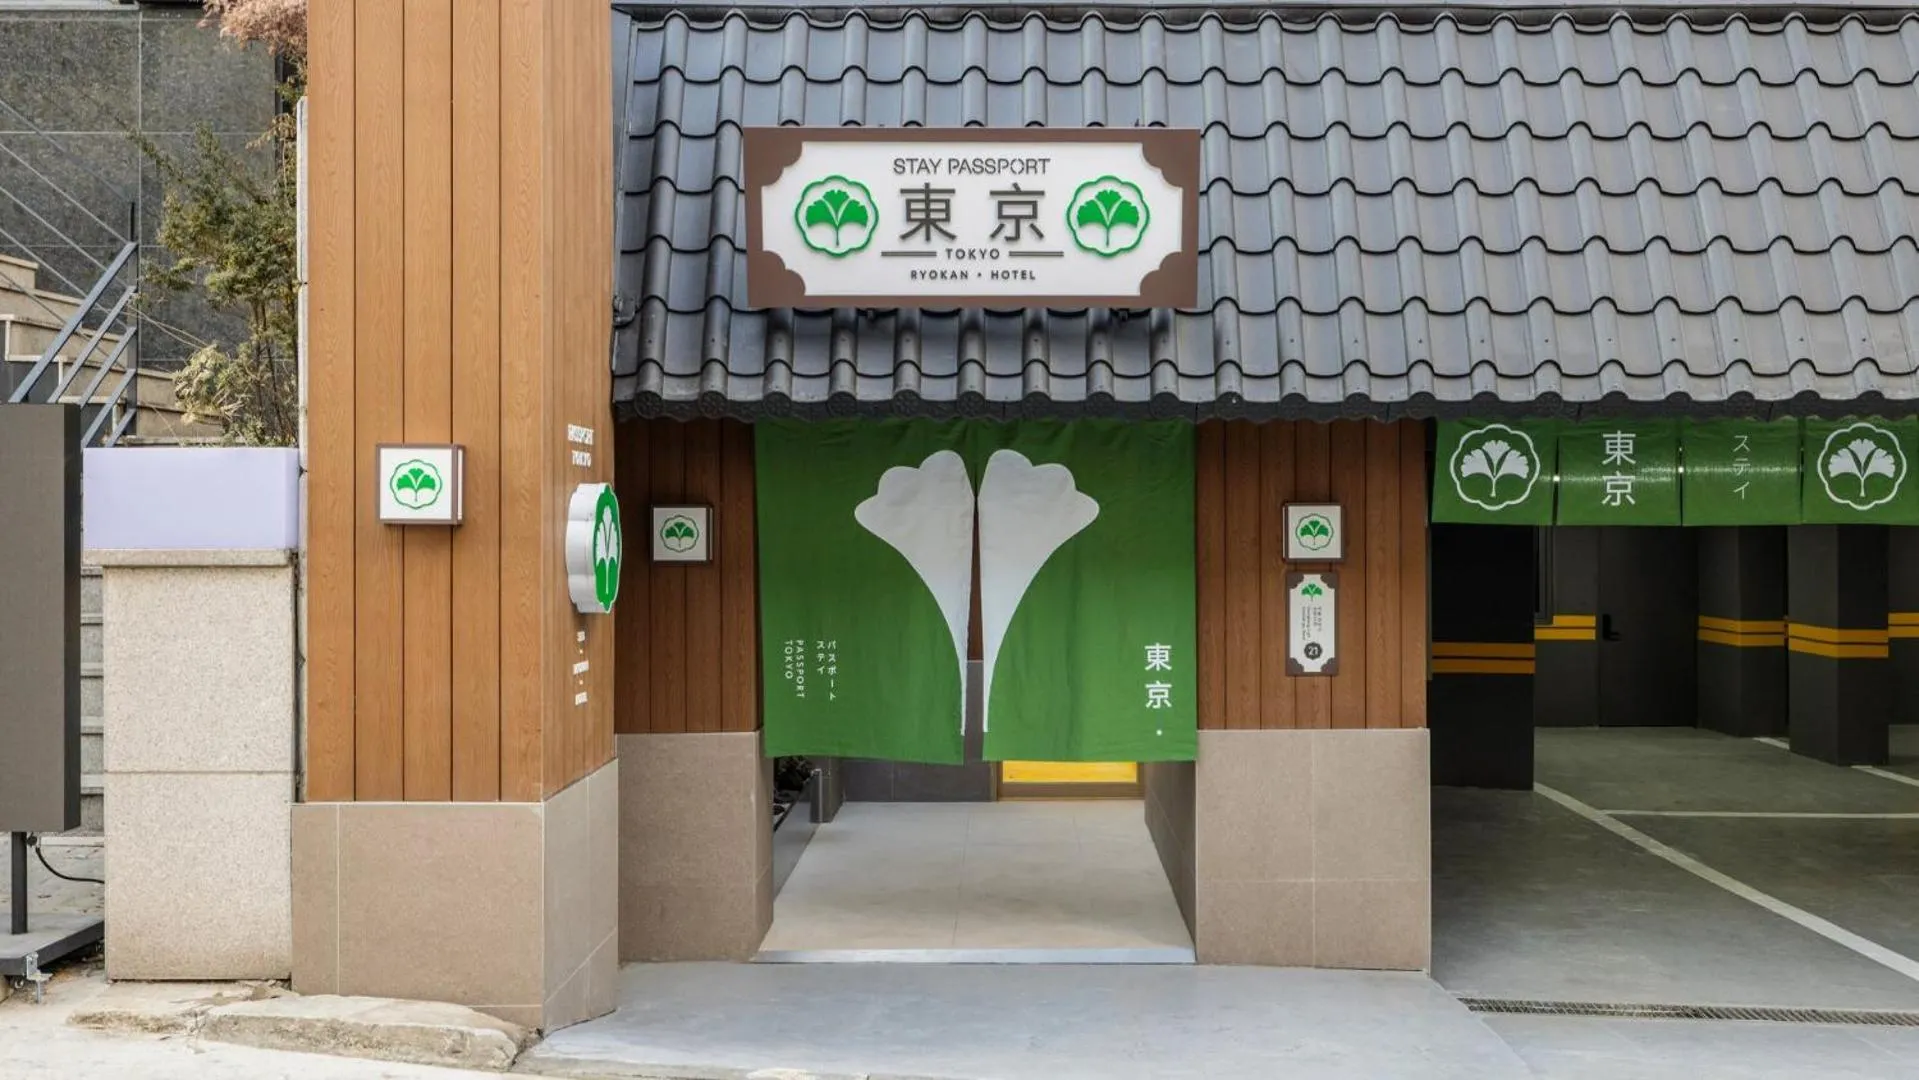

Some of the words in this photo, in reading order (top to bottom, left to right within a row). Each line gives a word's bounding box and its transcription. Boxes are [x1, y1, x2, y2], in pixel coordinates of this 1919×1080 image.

[893, 158, 943, 175] STAY
[948, 158, 1051, 175] PASSPORT
[899, 182, 1045, 243] 東京
[910, 269, 969, 281] RYOKAN
[990, 269, 1037, 281] HOTEL
[945, 248, 1000, 261] TOKYO
[1601, 430, 1637, 506] 東京
[1732, 435, 1751, 500] ステイ
[784, 640, 794, 679] TOKYO
[796, 640, 805, 698] PASSPORT
[815, 640, 826, 675] ステイ
[1144, 642, 1173, 709] 東京
